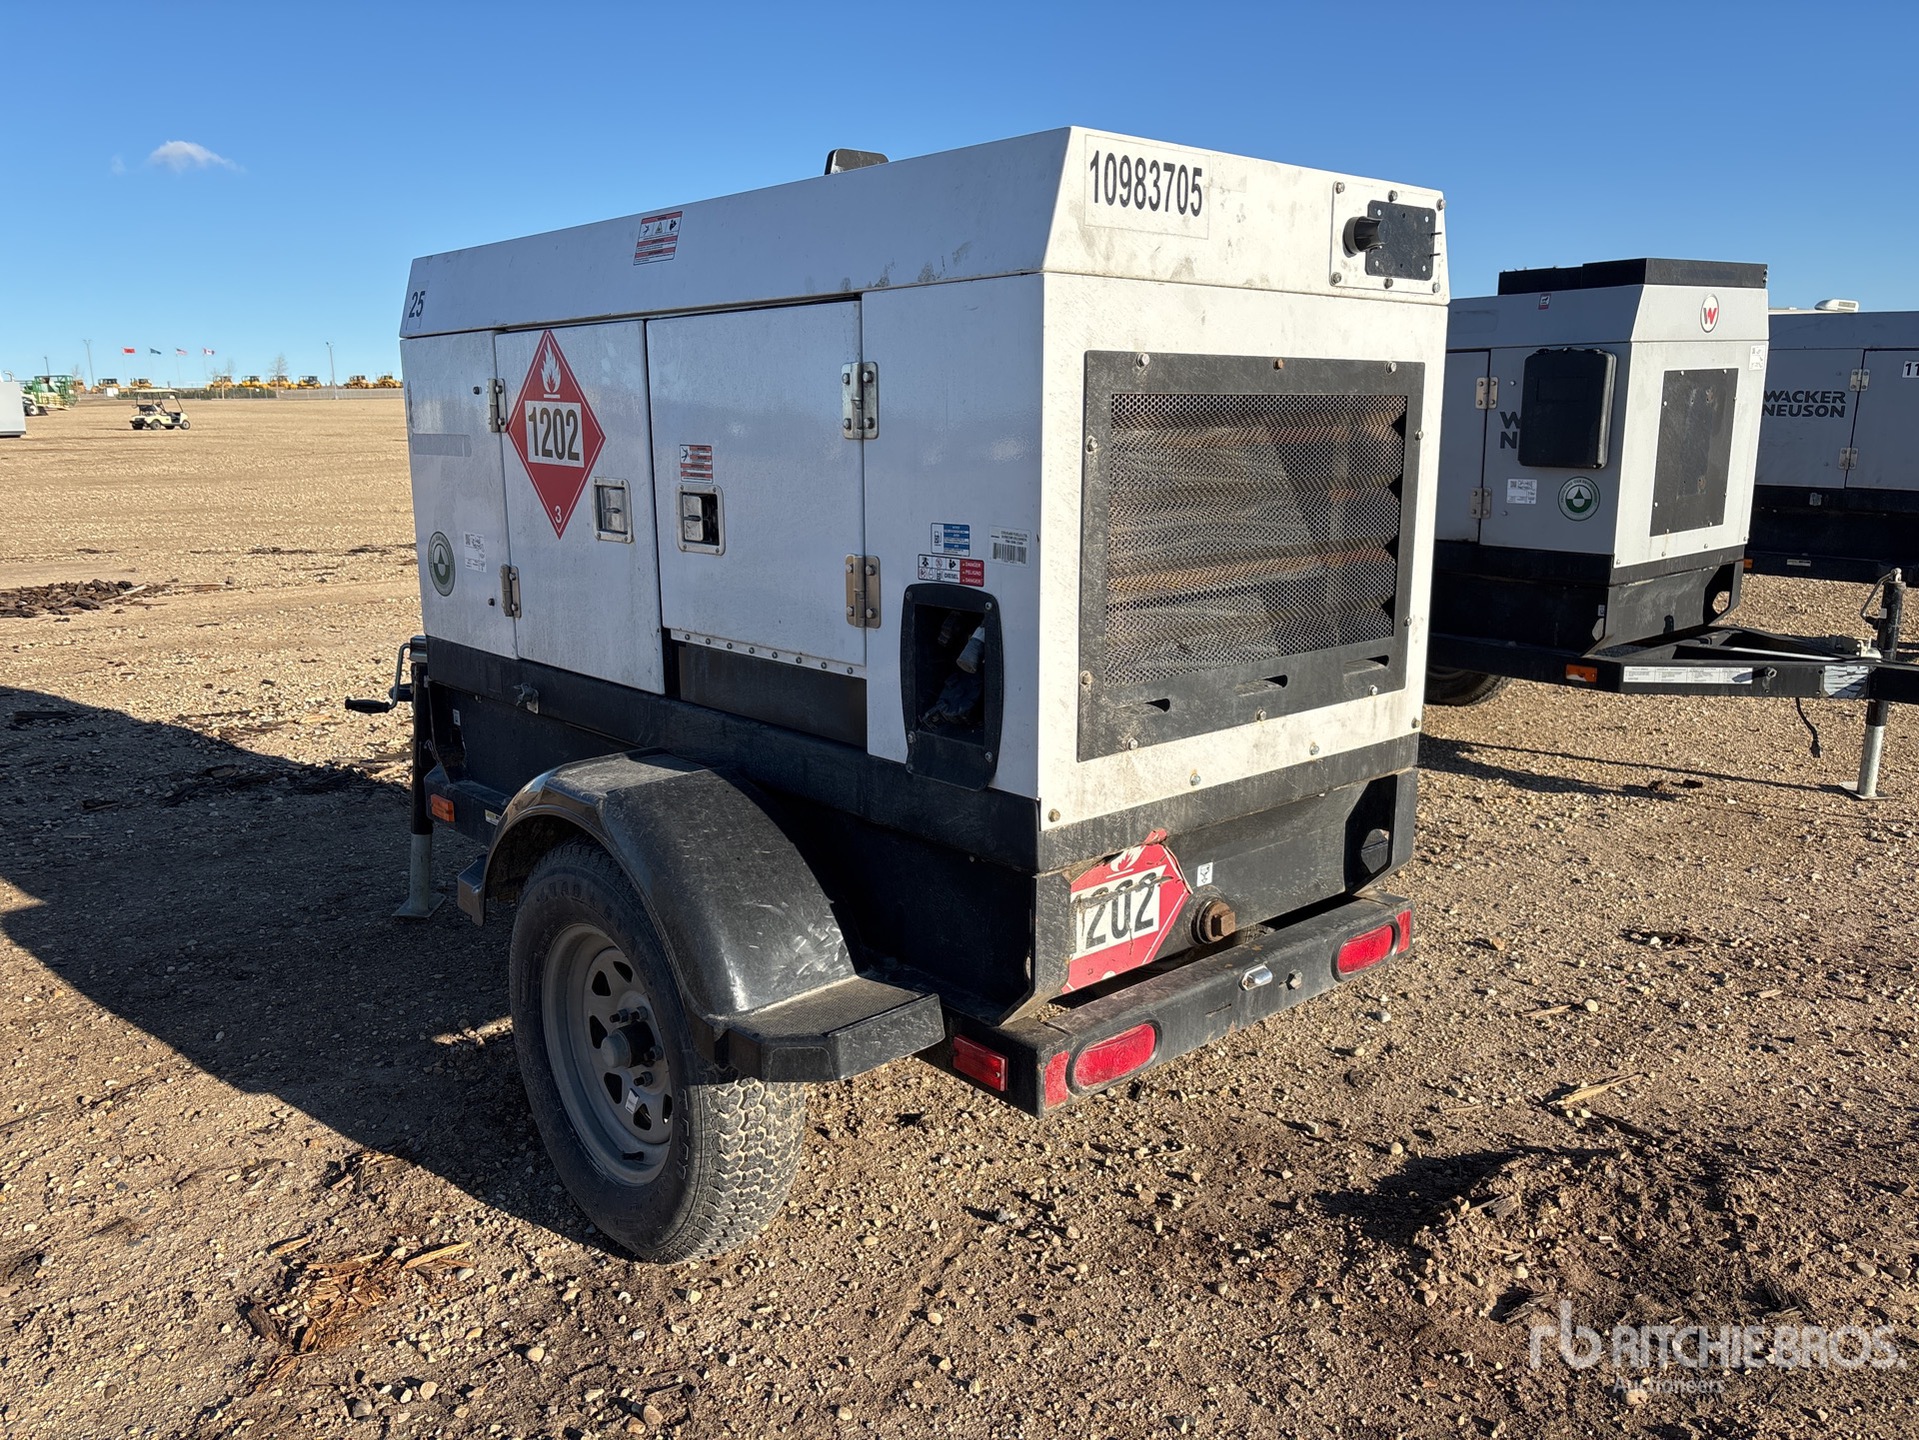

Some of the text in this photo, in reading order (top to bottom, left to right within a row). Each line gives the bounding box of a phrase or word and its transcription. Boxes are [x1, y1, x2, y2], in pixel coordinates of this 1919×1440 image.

[1090, 150, 1203, 217] 10983705
[409, 291, 426, 318] 25
[1763, 390, 1846, 404] WACKER
[1762, 404, 1846, 418] NEUSON
[528, 406, 580, 461] 1202
[555, 505, 562, 523] 3
